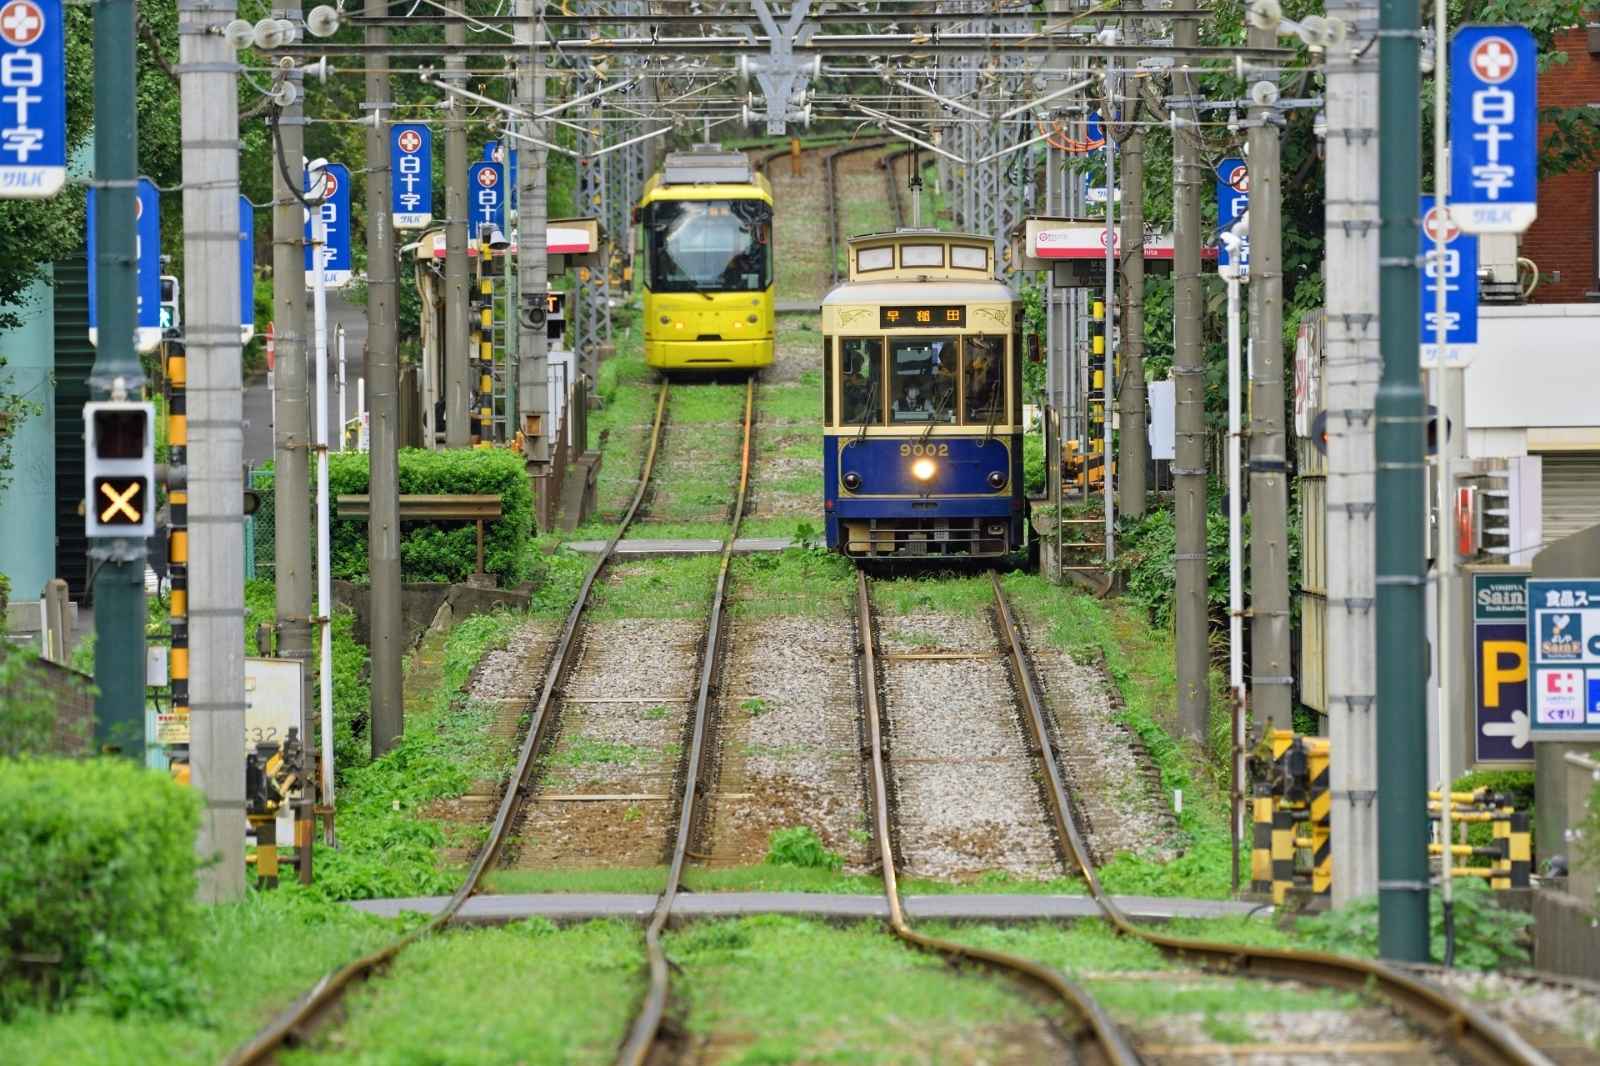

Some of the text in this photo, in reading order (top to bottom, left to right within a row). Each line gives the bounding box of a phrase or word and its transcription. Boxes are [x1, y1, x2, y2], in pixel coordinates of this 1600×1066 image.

[1, 48, 44, 163] 白十字
[1471, 86, 1516, 201] 白十字
[400, 155, 421, 211] 白十字
[899, 443, 950, 457] 9002
[1477, 588, 1526, 606] Sain
[1482, 640, 1528, 708] P
[1547, 708, 1576, 721] くすり
